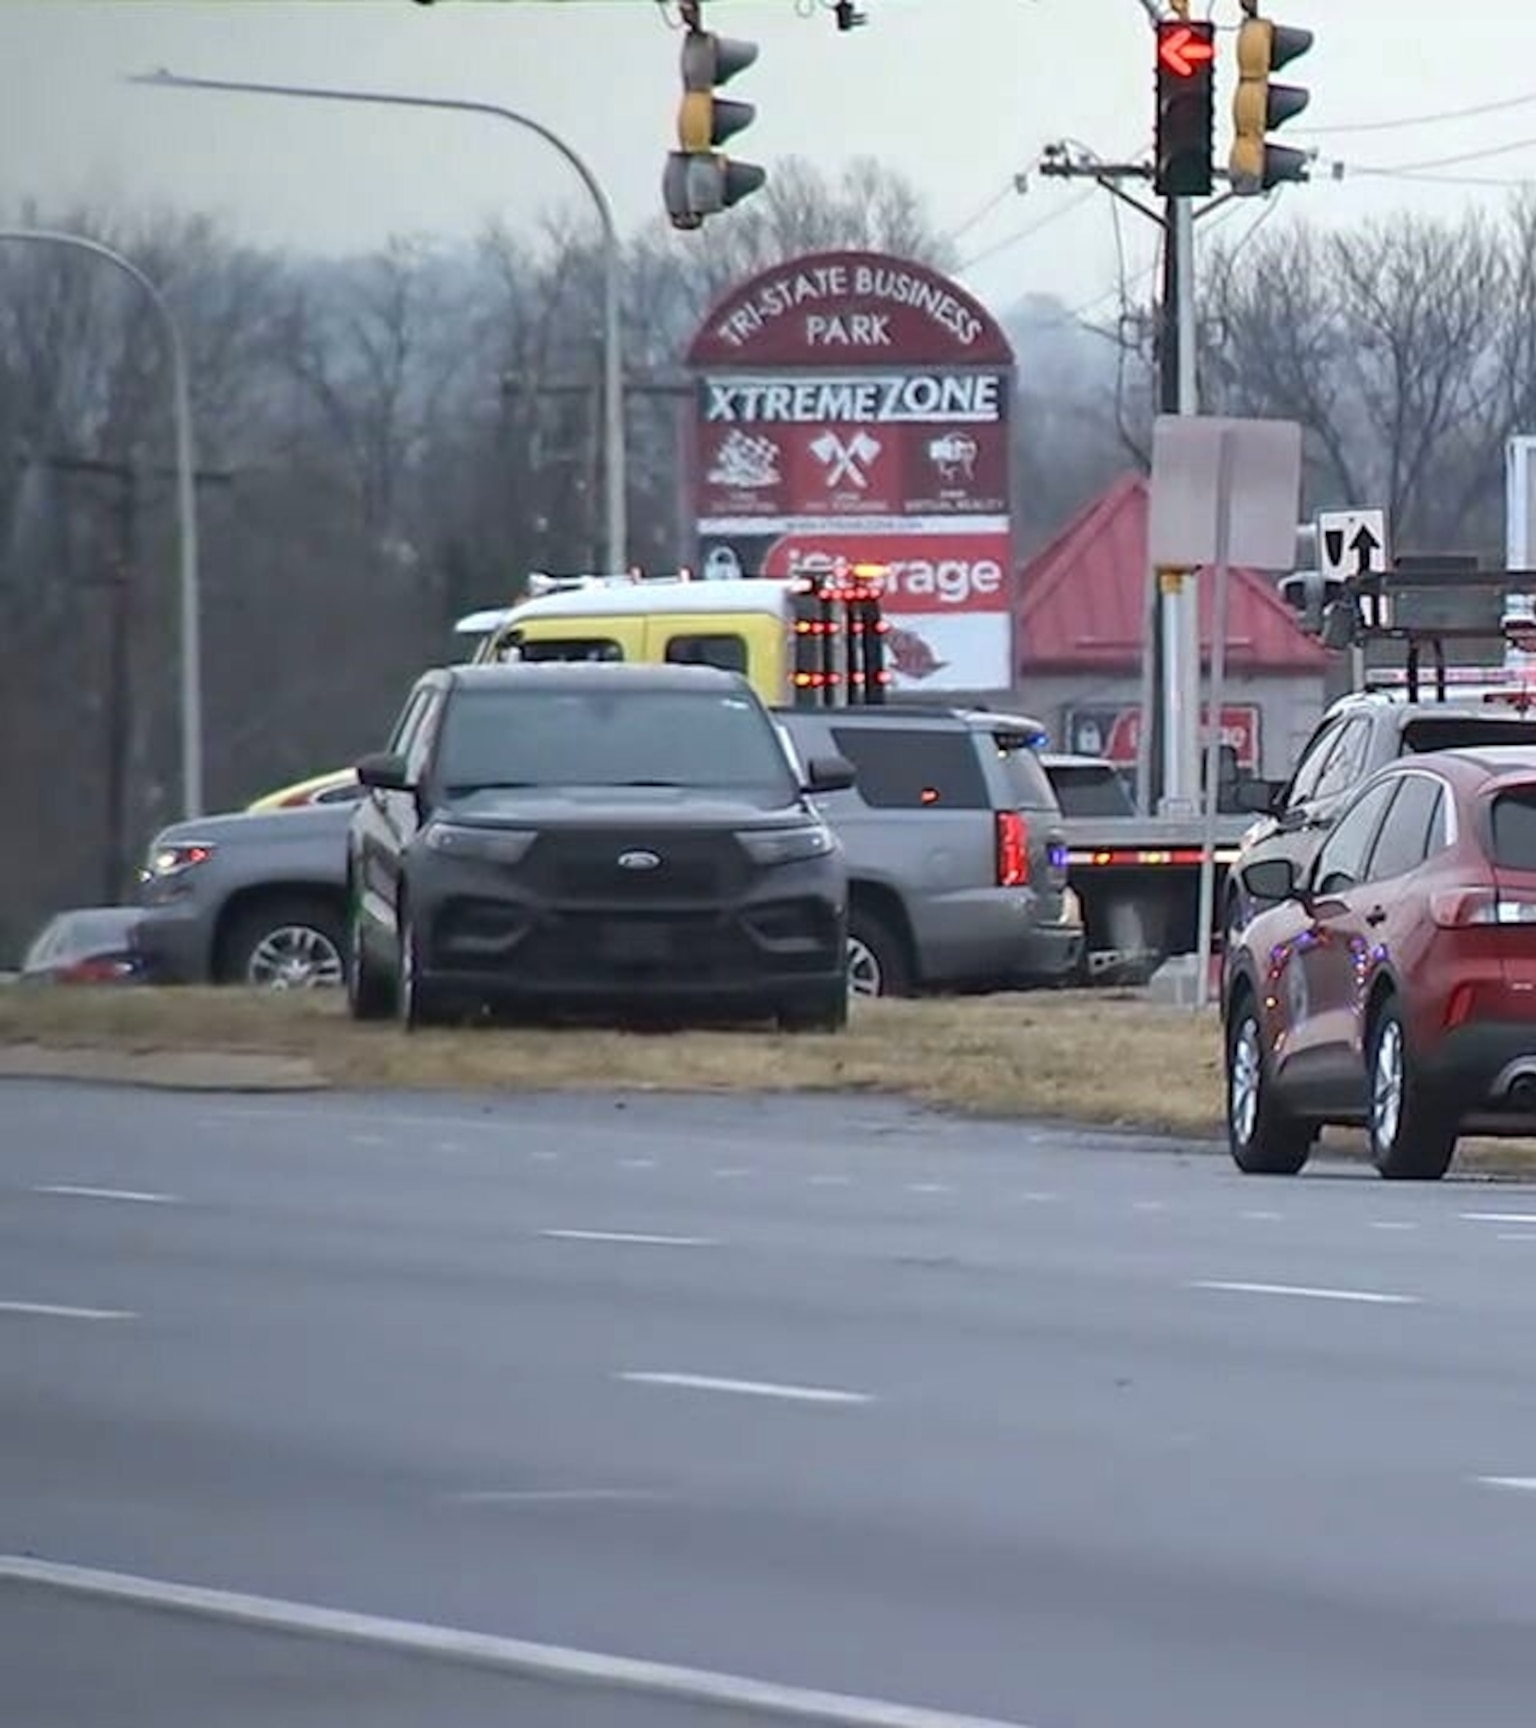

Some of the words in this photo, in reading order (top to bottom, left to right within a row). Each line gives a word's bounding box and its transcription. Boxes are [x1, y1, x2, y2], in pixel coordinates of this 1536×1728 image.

[718, 266, 847, 346] TRI-STATE
[855, 266, 983, 346] BUSINESS
[806, 314, 891, 346] PARK
[707, 375, 999, 422] XTREMEZONE
